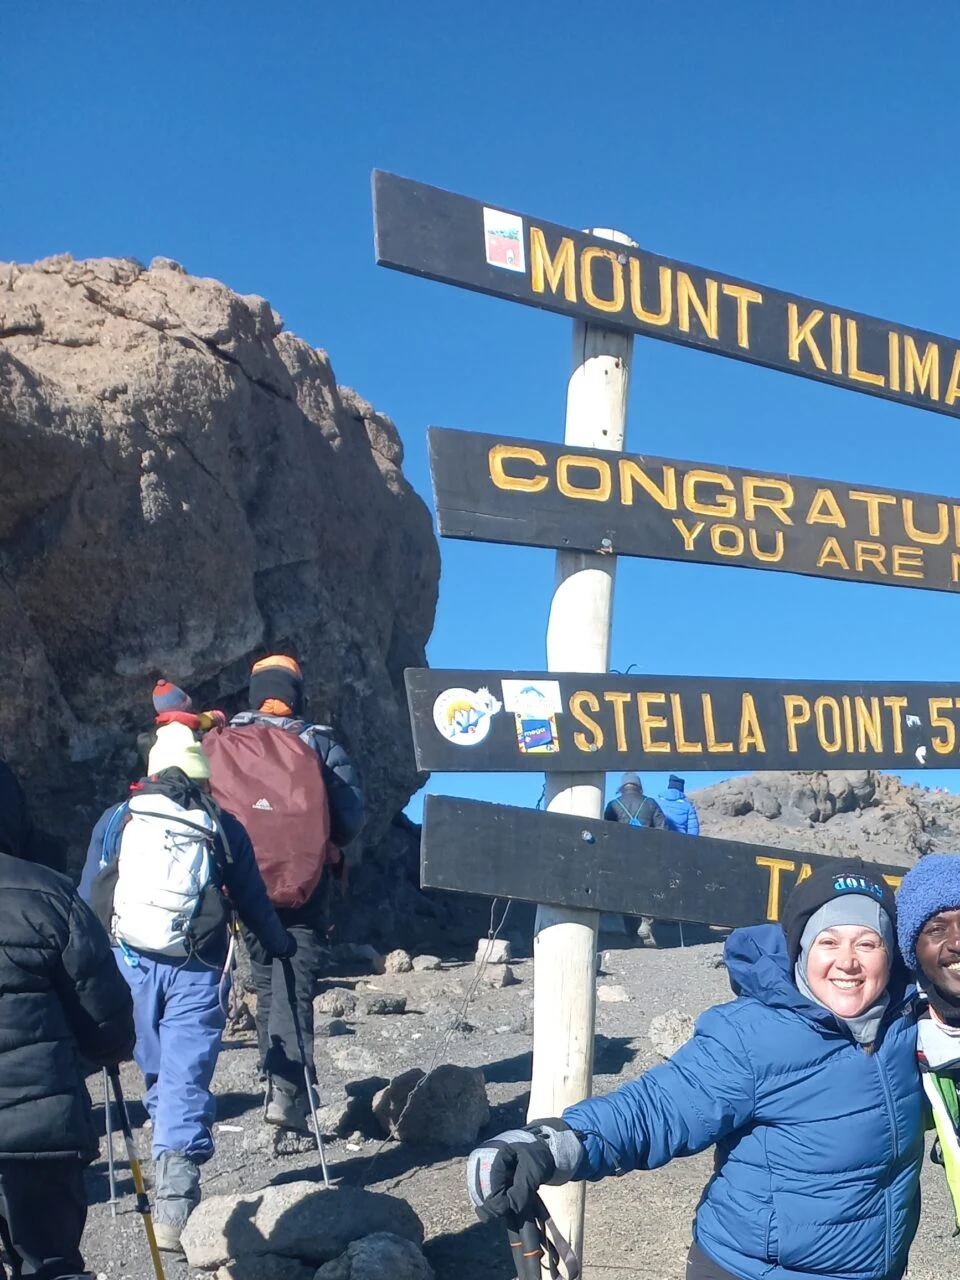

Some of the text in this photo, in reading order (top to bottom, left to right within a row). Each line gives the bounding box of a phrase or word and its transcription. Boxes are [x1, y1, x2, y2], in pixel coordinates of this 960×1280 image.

[529, 226, 763, 349] MOUNT
[672, 517, 785, 563] YOU
[816, 537, 925, 579] ARE
[568, 690, 766, 754] STELLA
[783, 694, 908, 754] POINT
